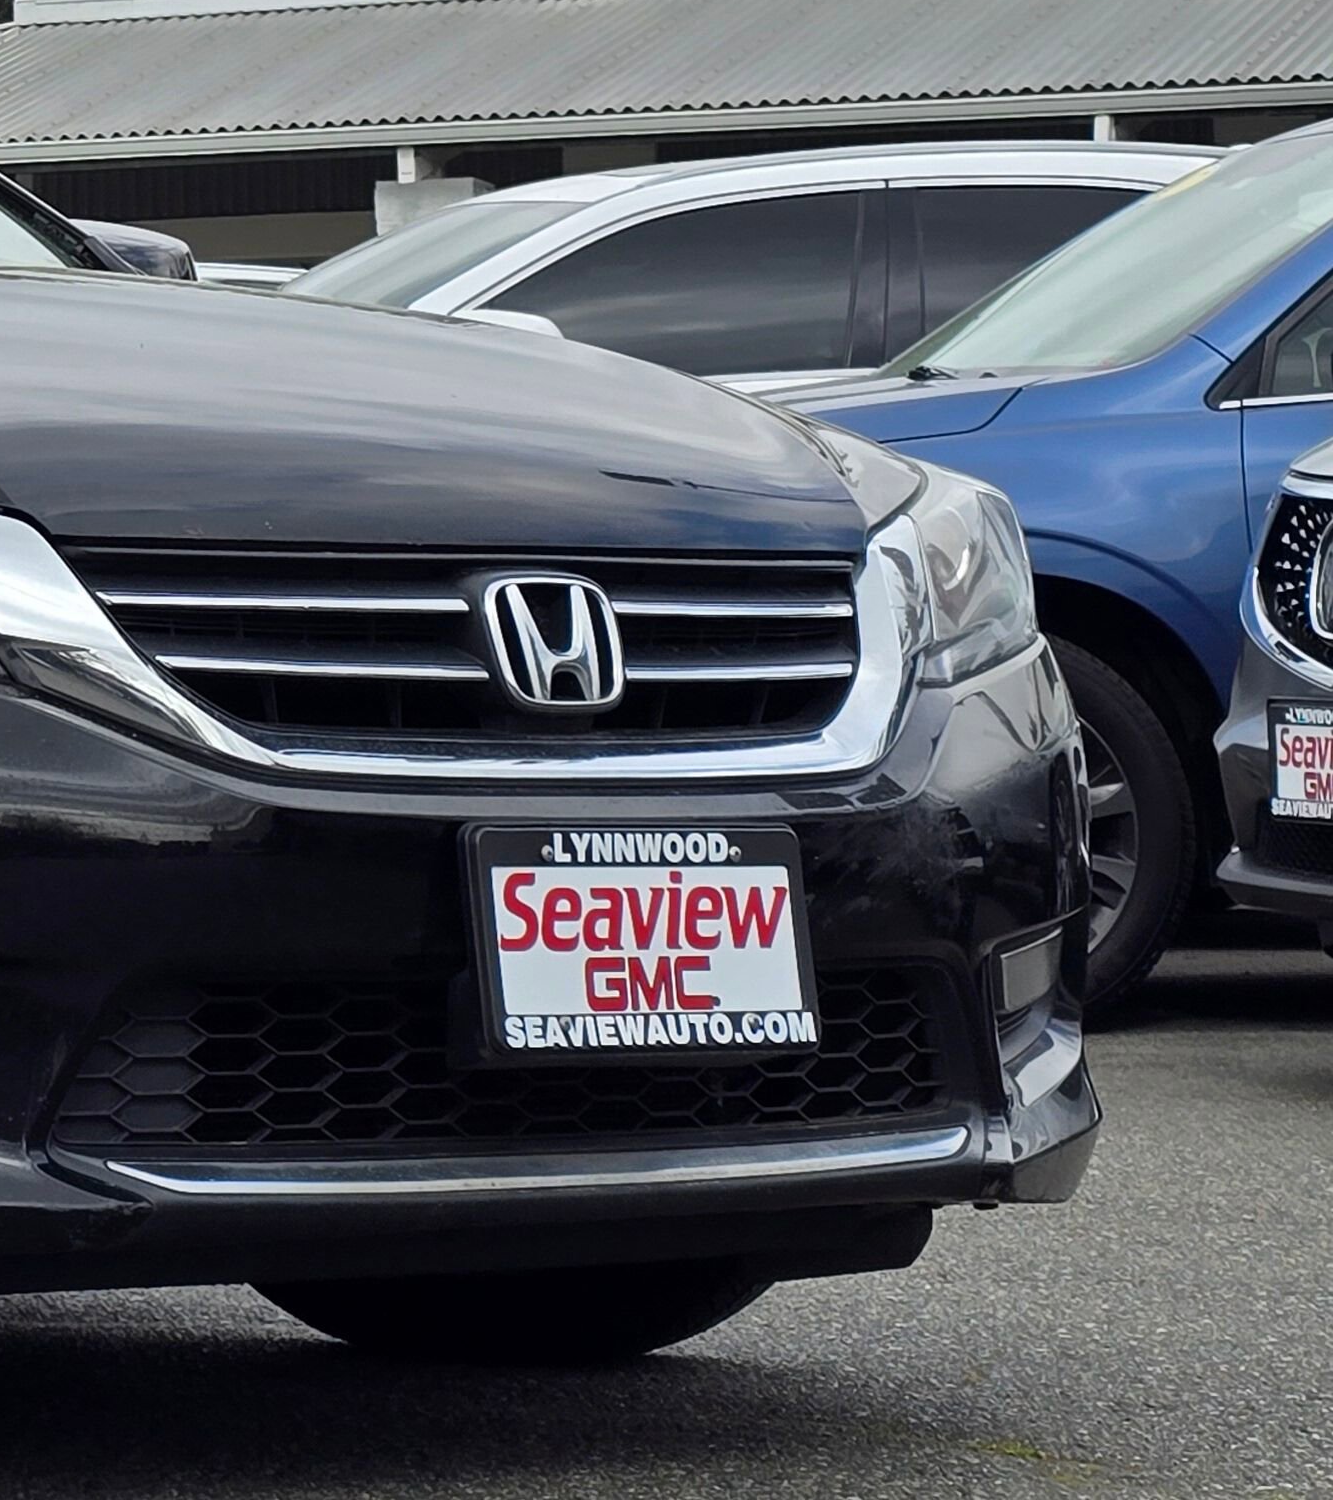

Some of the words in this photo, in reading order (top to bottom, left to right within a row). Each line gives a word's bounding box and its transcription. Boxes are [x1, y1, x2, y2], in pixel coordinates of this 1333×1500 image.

[552, 832, 729, 863] LYNNWOOD
[500, 871, 787, 952] Seaview
[585, 956, 720, 1011] GMC
[504, 1011, 818, 1049] SEAVIEWAUTO.COM
